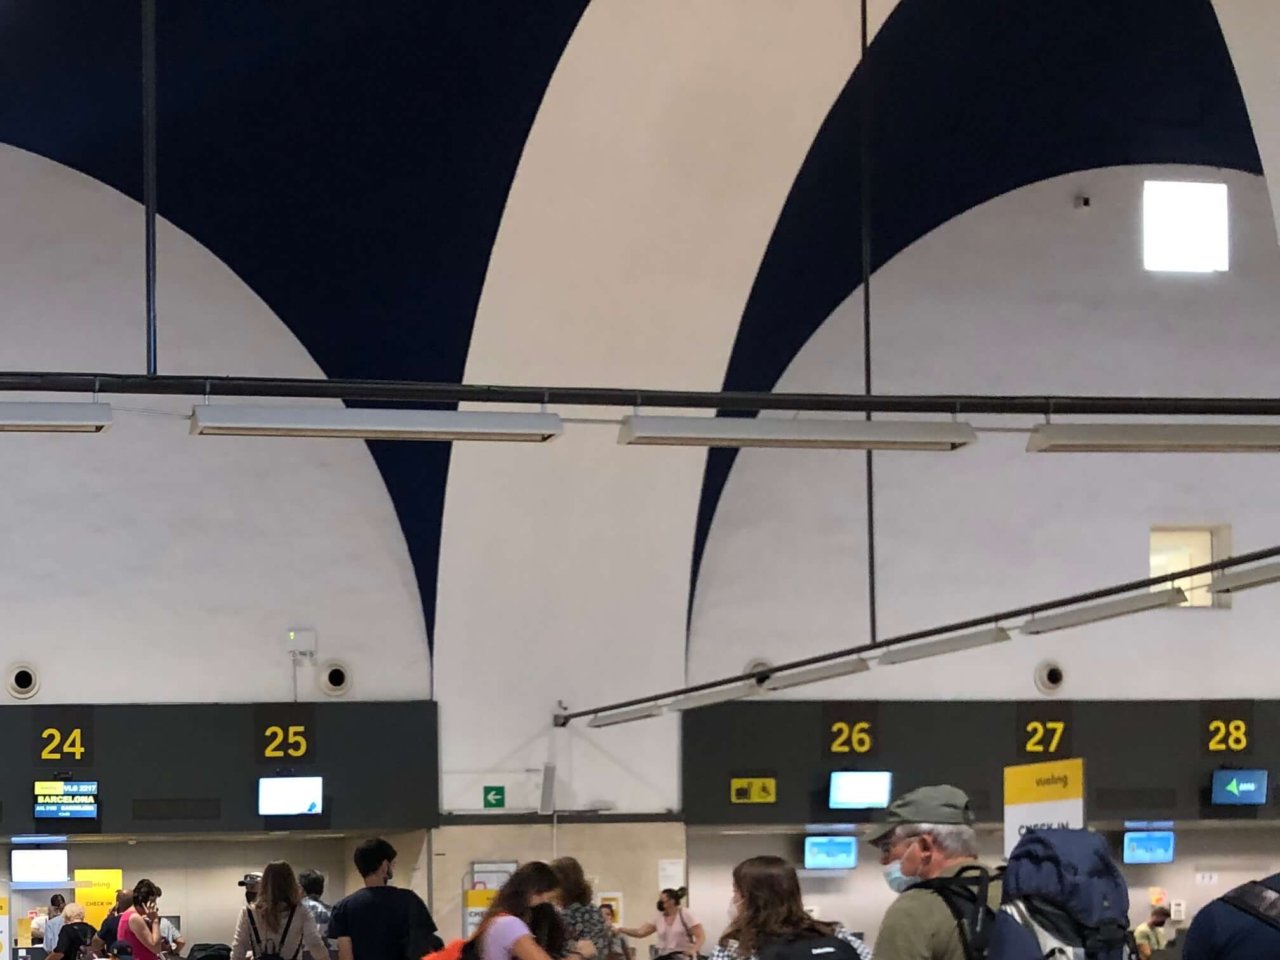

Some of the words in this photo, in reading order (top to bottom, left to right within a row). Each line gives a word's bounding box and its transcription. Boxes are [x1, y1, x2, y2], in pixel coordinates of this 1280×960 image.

[41, 728, 85, 760] 24
[264, 726, 307, 757] 25
[830, 721, 872, 753] 26
[1025, 721, 1065, 752] 27
[1208, 720, 1247, 751] 28
[1035, 773, 1068, 789] vueling
[37, 795, 95, 804] BARCELONA
